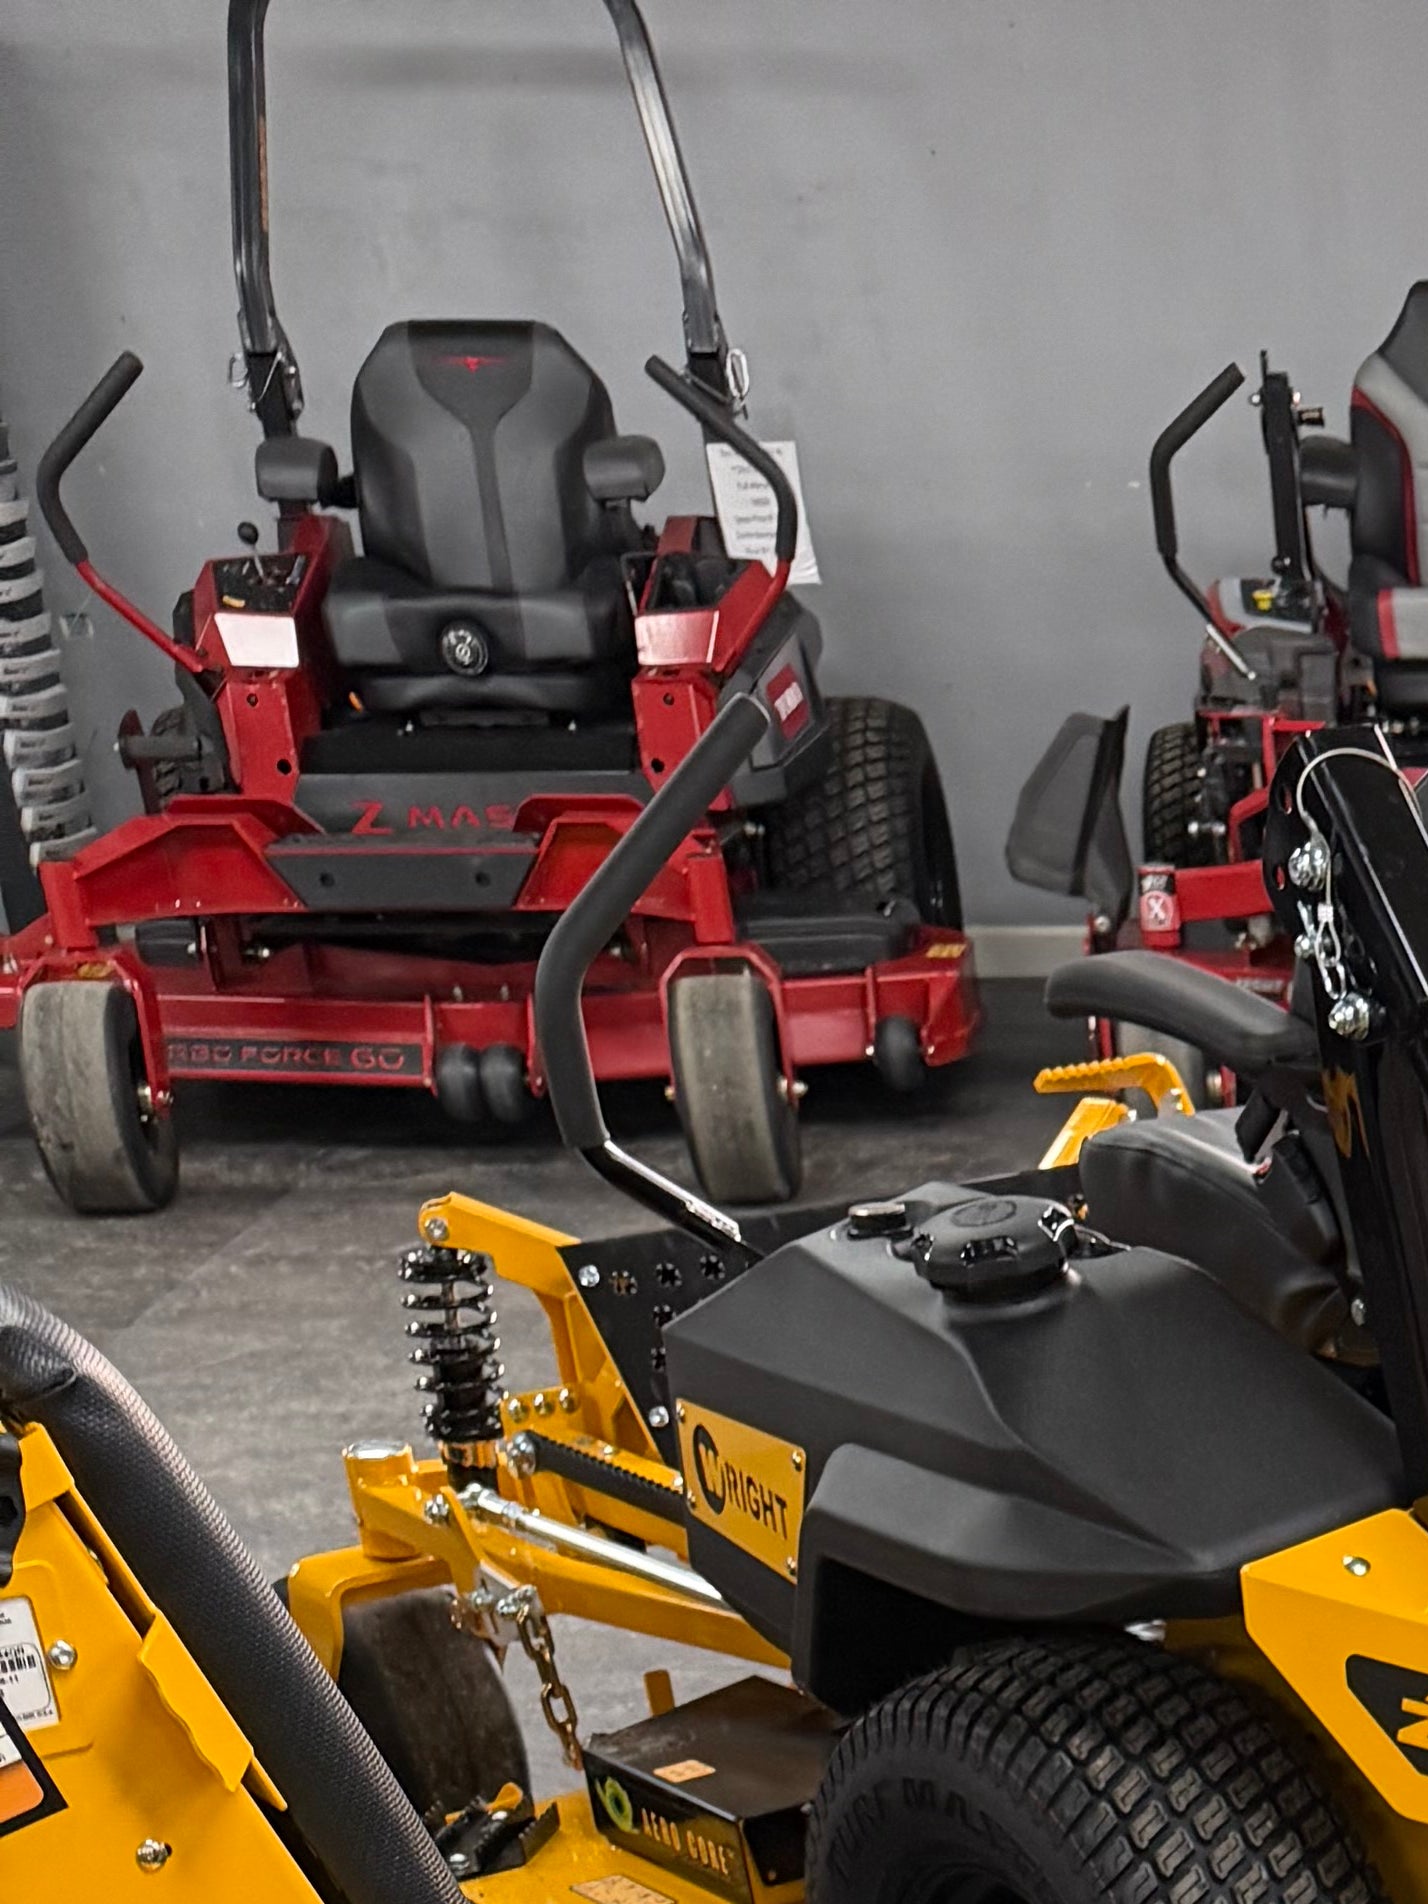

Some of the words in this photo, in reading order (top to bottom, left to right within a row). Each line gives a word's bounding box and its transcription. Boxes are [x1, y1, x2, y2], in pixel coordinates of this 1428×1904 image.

[351, 798, 393, 836] Z
[693, 1424, 788, 1540] WRIGHT
[641, 1807, 681, 1852] AERO
[687, 1829, 729, 1876] CORE
